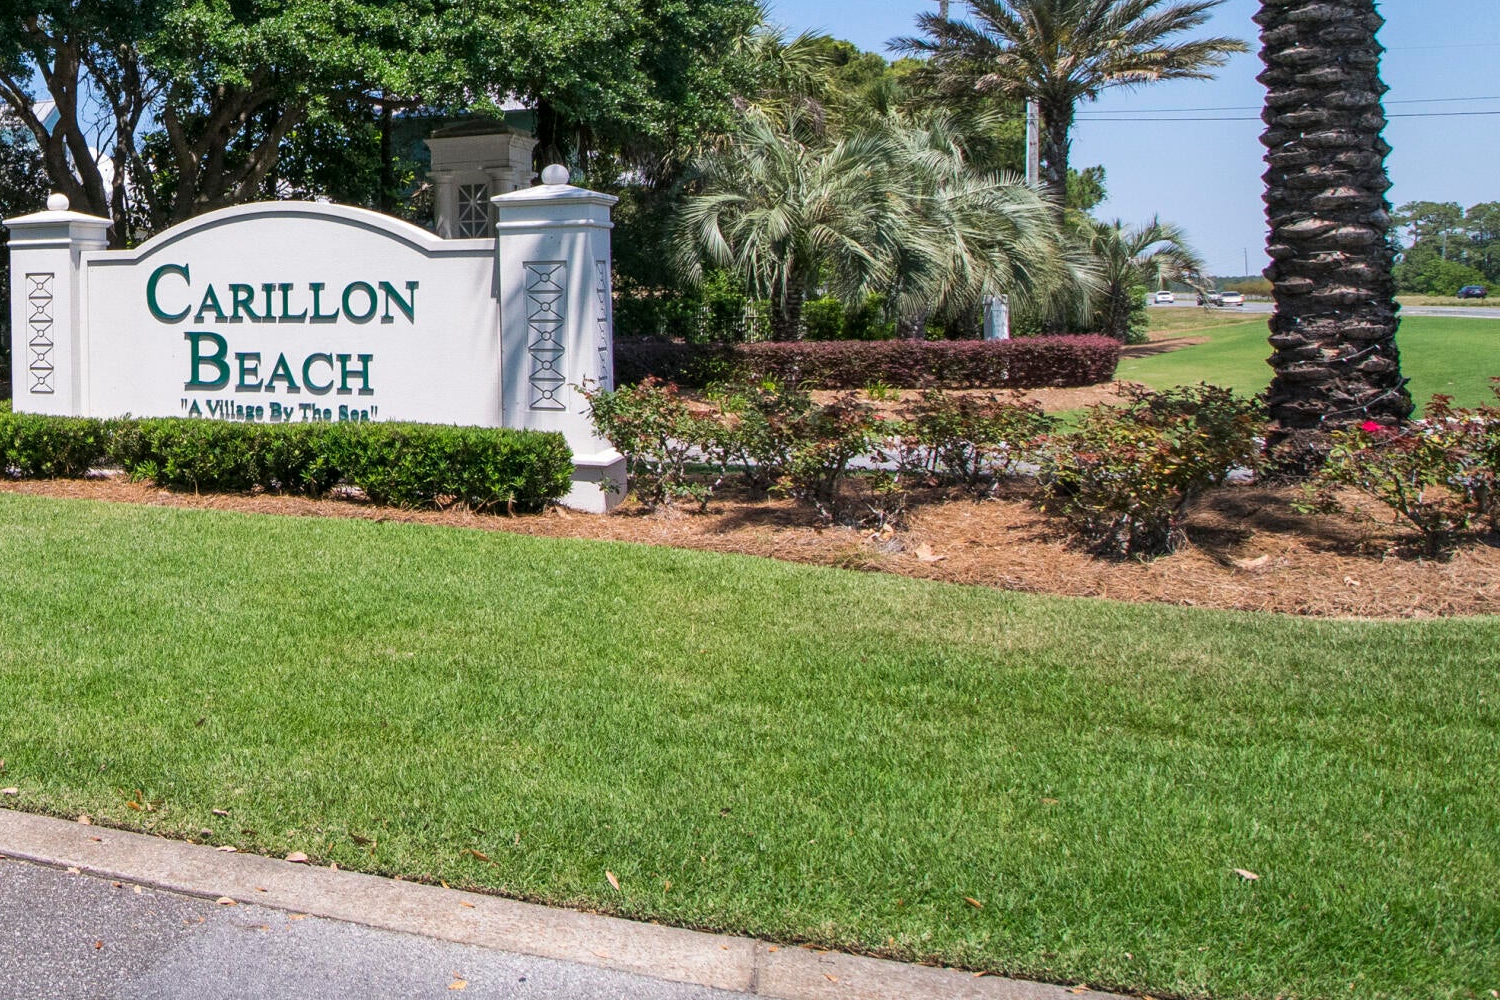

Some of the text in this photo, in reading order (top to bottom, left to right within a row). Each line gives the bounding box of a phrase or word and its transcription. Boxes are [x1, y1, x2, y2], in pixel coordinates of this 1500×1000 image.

[146, 263, 420, 324] CARILLON
[184, 331, 374, 395] BEACH
[206, 400, 264, 421] Village
[269, 402, 294, 422] By
[299, 403, 332, 421] The
